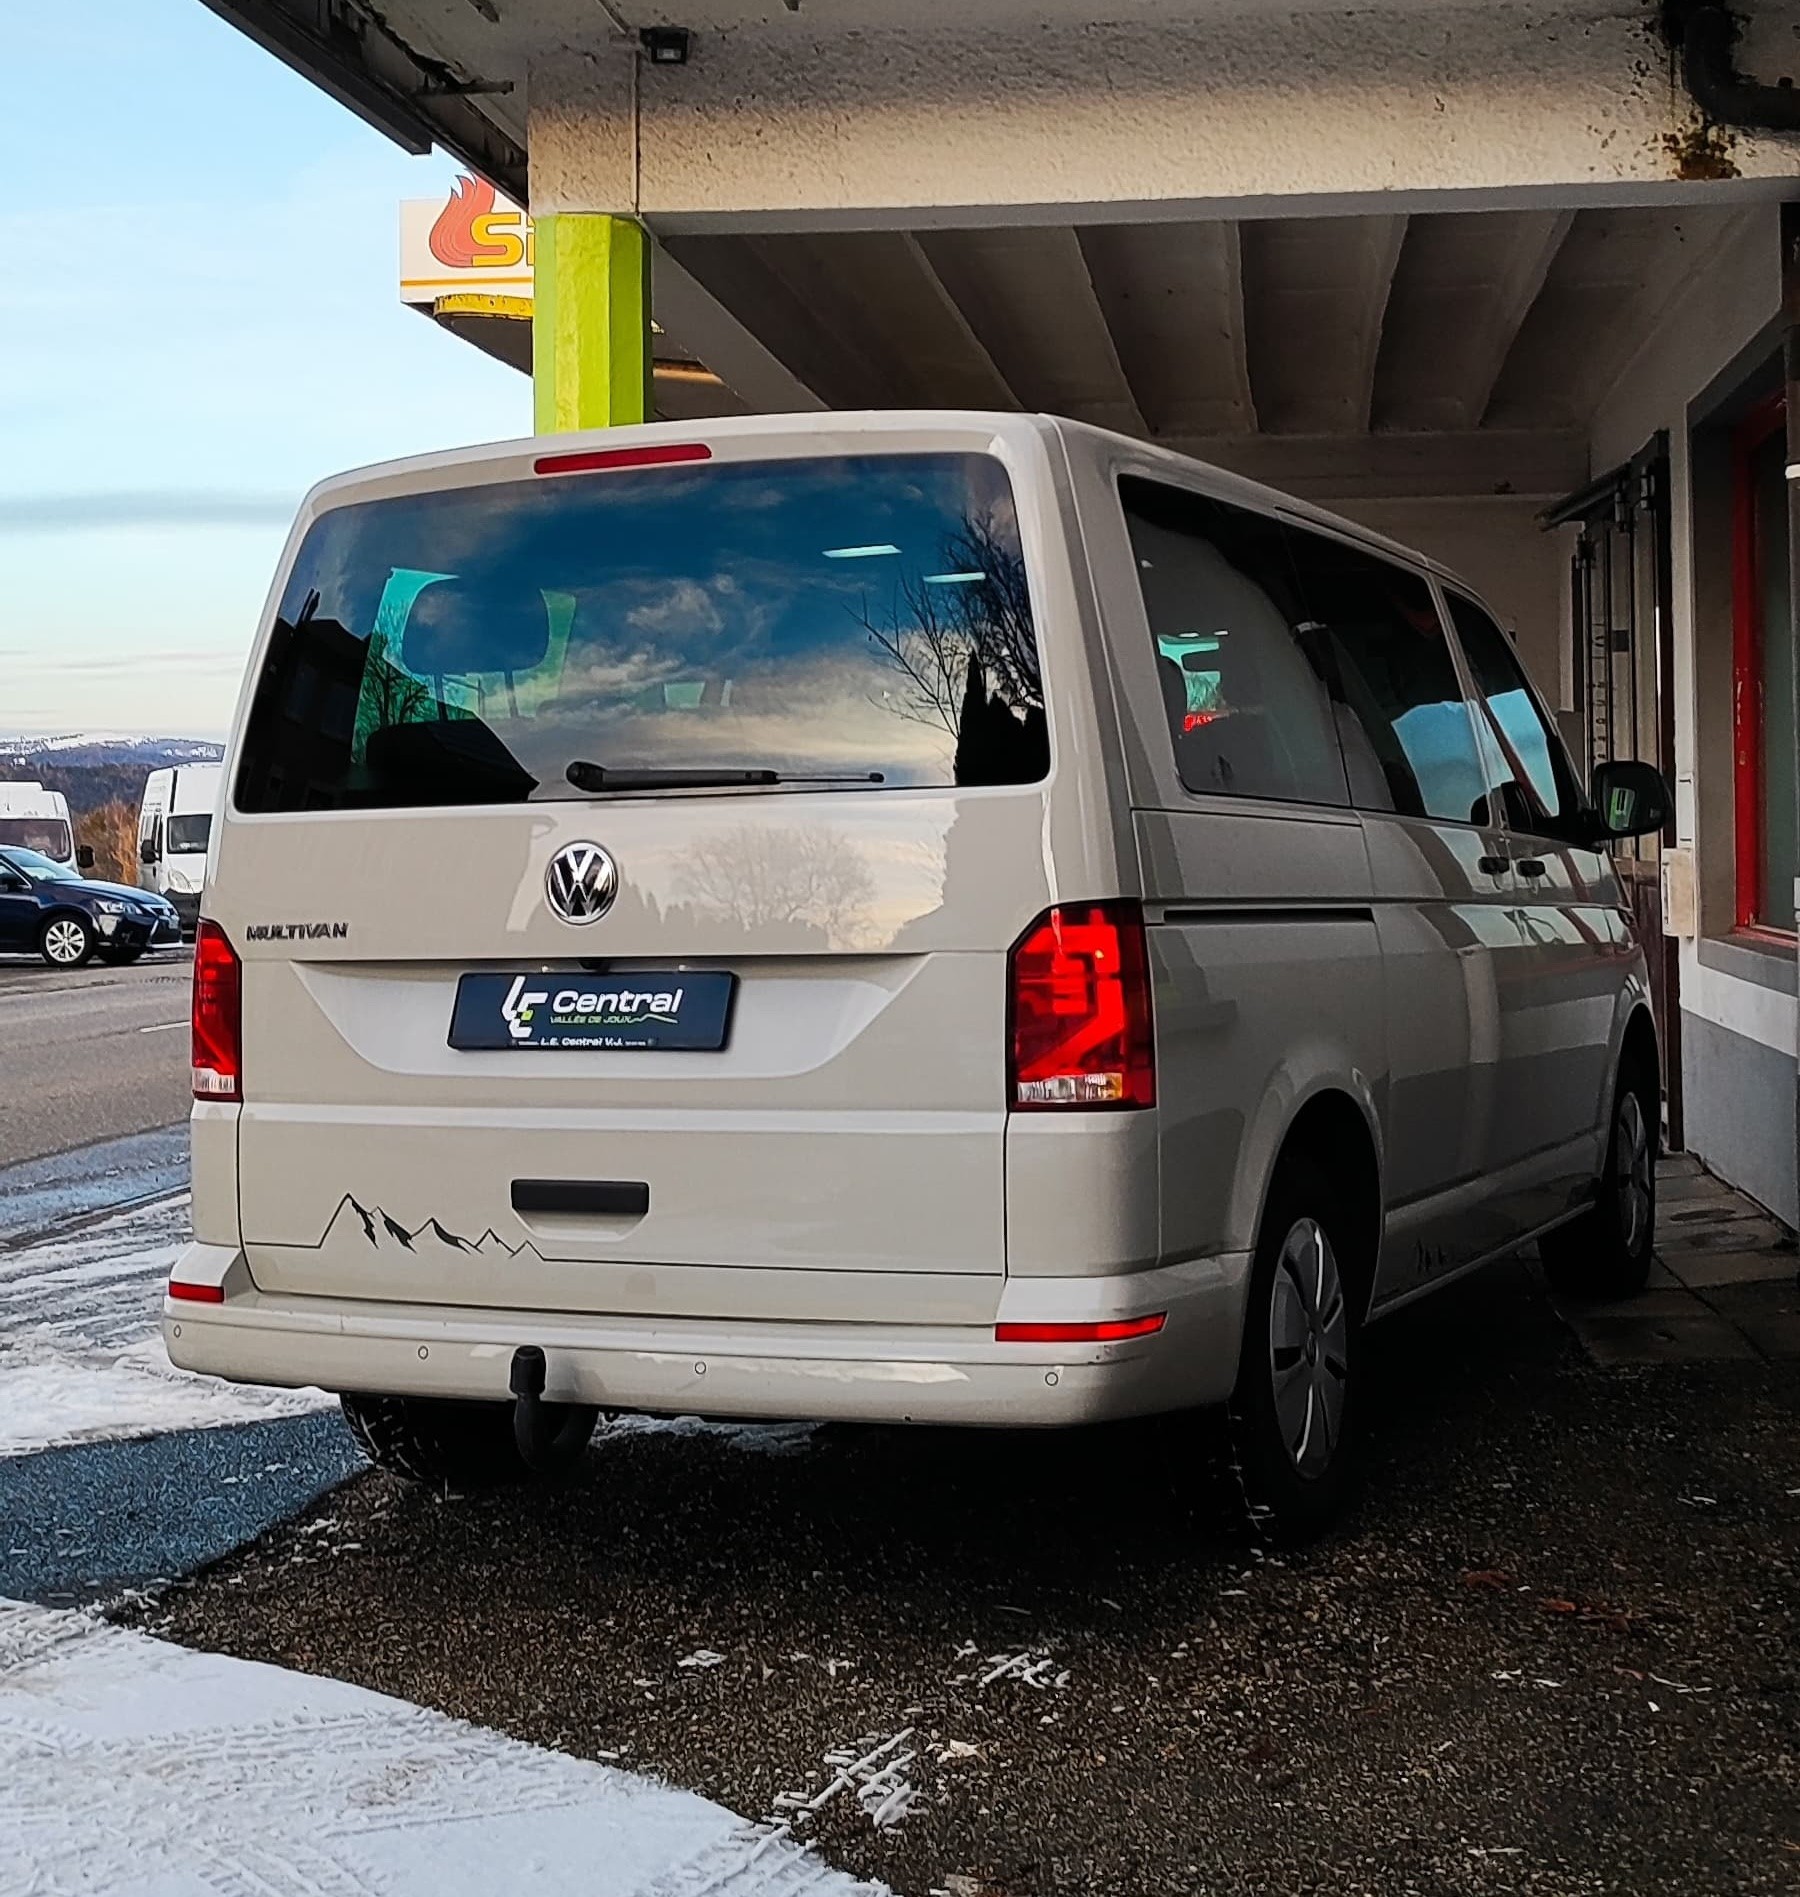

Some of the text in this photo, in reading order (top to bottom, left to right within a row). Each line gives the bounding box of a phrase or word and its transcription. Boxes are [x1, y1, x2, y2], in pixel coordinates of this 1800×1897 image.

[549, 845, 613, 921] VW
[245, 922, 349, 941] MULTIVAN
[552, 988, 684, 1014] Central
[587, 1015, 602, 1024] DE
[561, 1037, 603, 1047] Central
